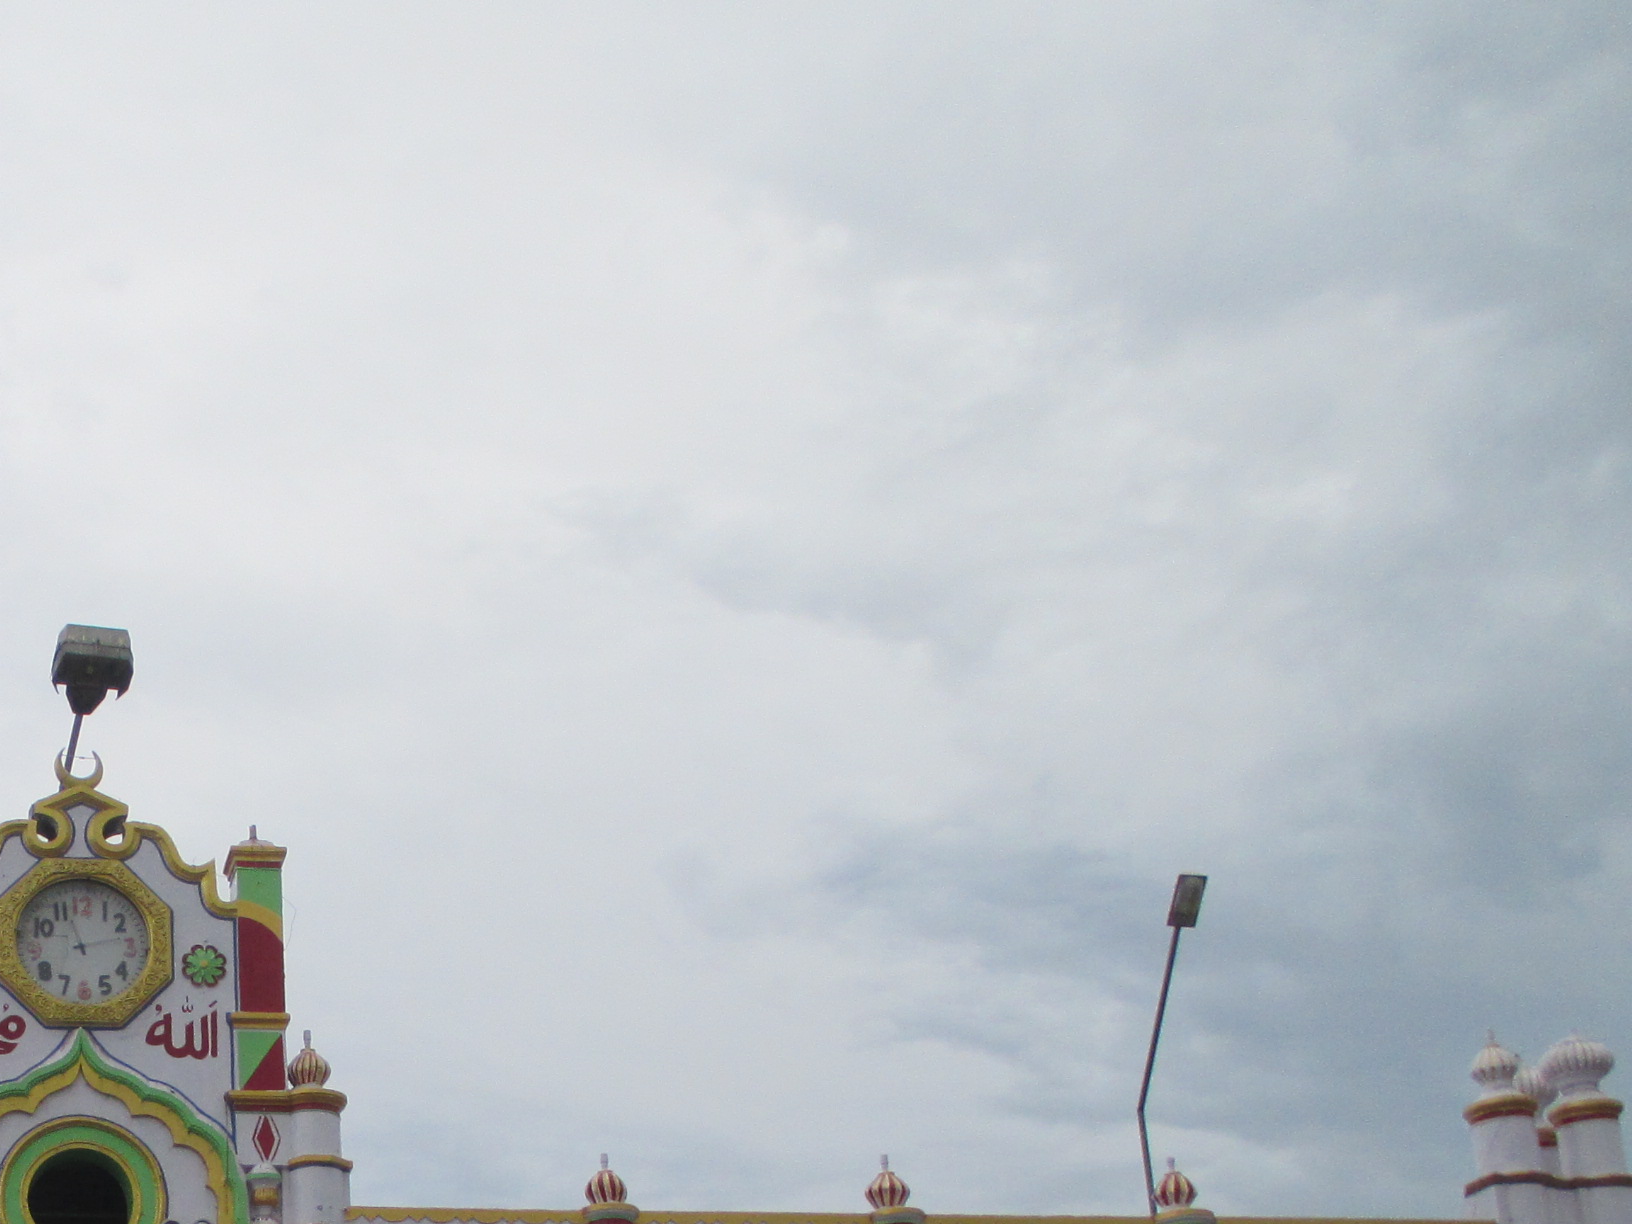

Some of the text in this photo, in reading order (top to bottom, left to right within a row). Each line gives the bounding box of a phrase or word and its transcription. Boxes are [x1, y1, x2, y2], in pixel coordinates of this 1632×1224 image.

[54, 903, 67, 921] 11
[73, 894, 92, 915] 12
[102, 900, 107, 921] 1
[33, 919, 54, 938] 10
[115, 913, 126, 932] 2
[29, 943, 42, 960] 9
[124, 939, 136, 958] 3
[38, 961, 52, 981] 8
[116, 961, 128, 980] 4
[59, 975, 70, 995] 7
[78, 979, 91, 1000] 6
[99, 975, 111, 995] 5
